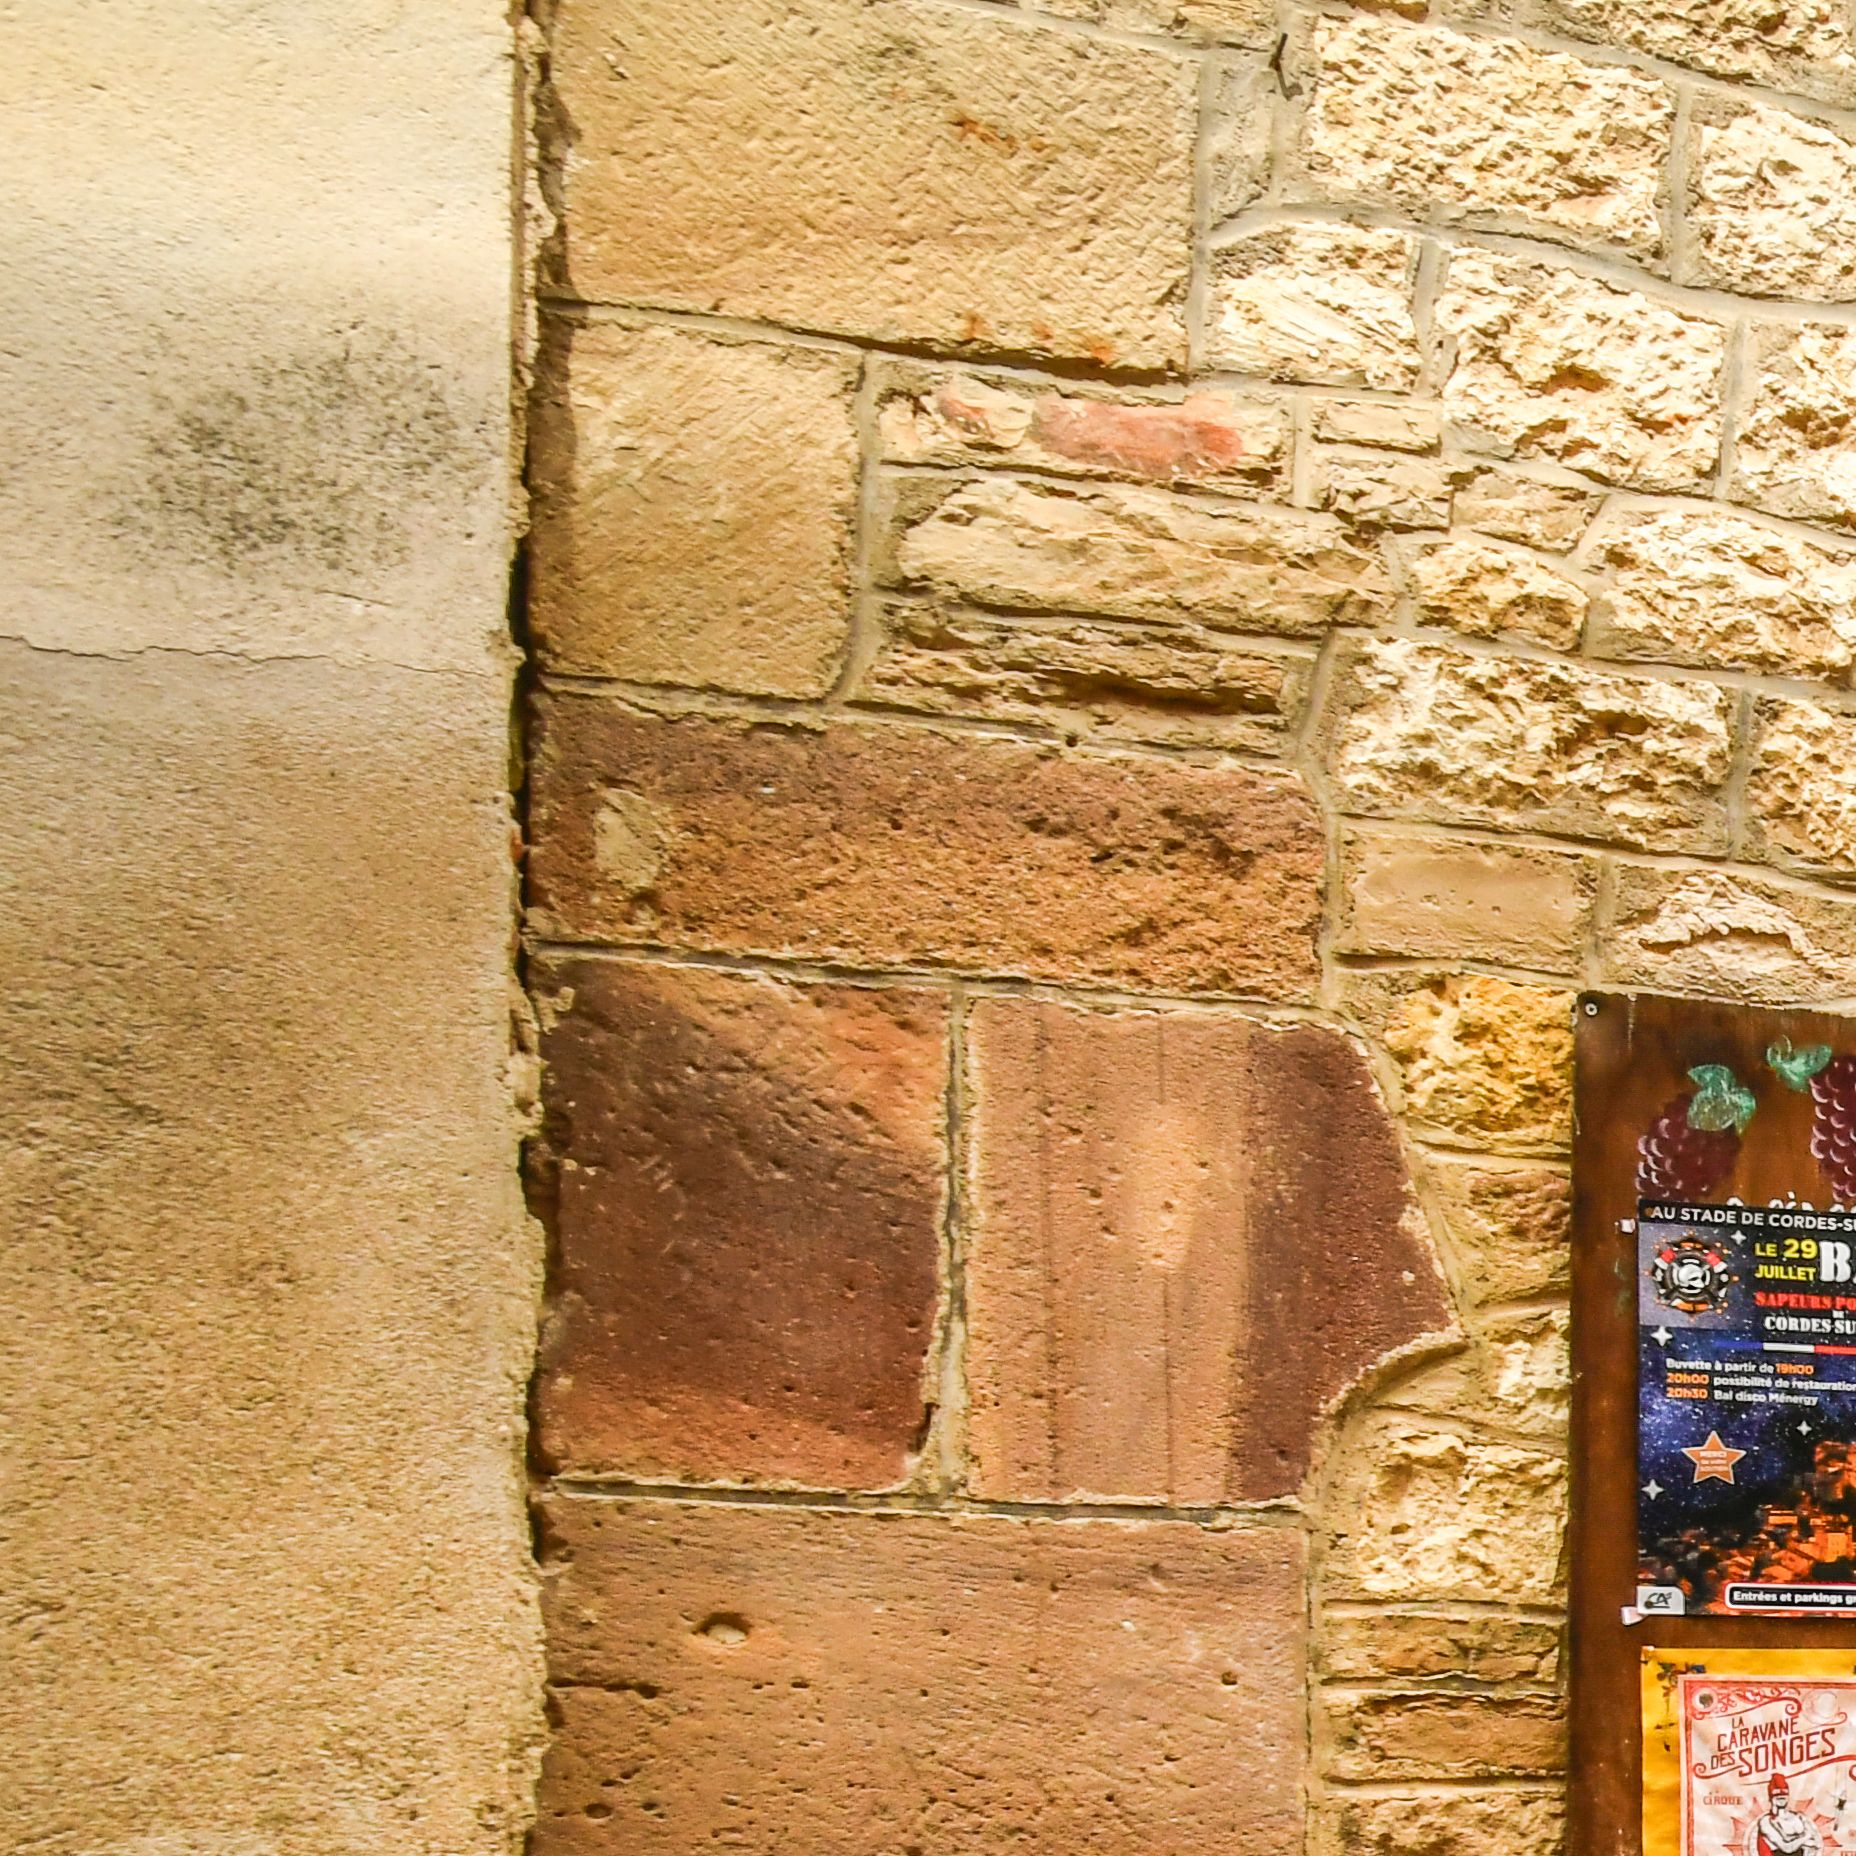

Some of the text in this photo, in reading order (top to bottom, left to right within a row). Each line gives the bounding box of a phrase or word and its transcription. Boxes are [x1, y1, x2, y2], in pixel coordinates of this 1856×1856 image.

[1651, 1206, 1676, 1220] AU
[1680, 1207, 1736, 1224] STADE
[1741, 1211, 1764, 1226] DE
[1755, 1238, 1818, 1259] LE 29
[1754, 1265, 1817, 1281] JUILLET
[1665, 1357, 1712, 1371] Buvette
[1714, 1359, 1722, 1372] à
[1724, 1361, 1757, 1375] partir
[1759, 1362, 1775, 1375] de
[1714, 1375, 1773, 1390] possibilité
[1775, 1376, 1791, 1389] de
[1714, 1389, 1734, 1402] Bal
[1736, 1390, 1768, 1403] disco
[1733, 1590, 1778, 1603] Entrées
[1779, 1592, 1793, 1603] et
[1794, 1592, 1844, 1607] parkings
[1731, 1718, 1745, 1730] LA
[1717, 1716, 1800, 1752] CARAVANE
[1710, 1727, 1836, 1778] DES SONGES
